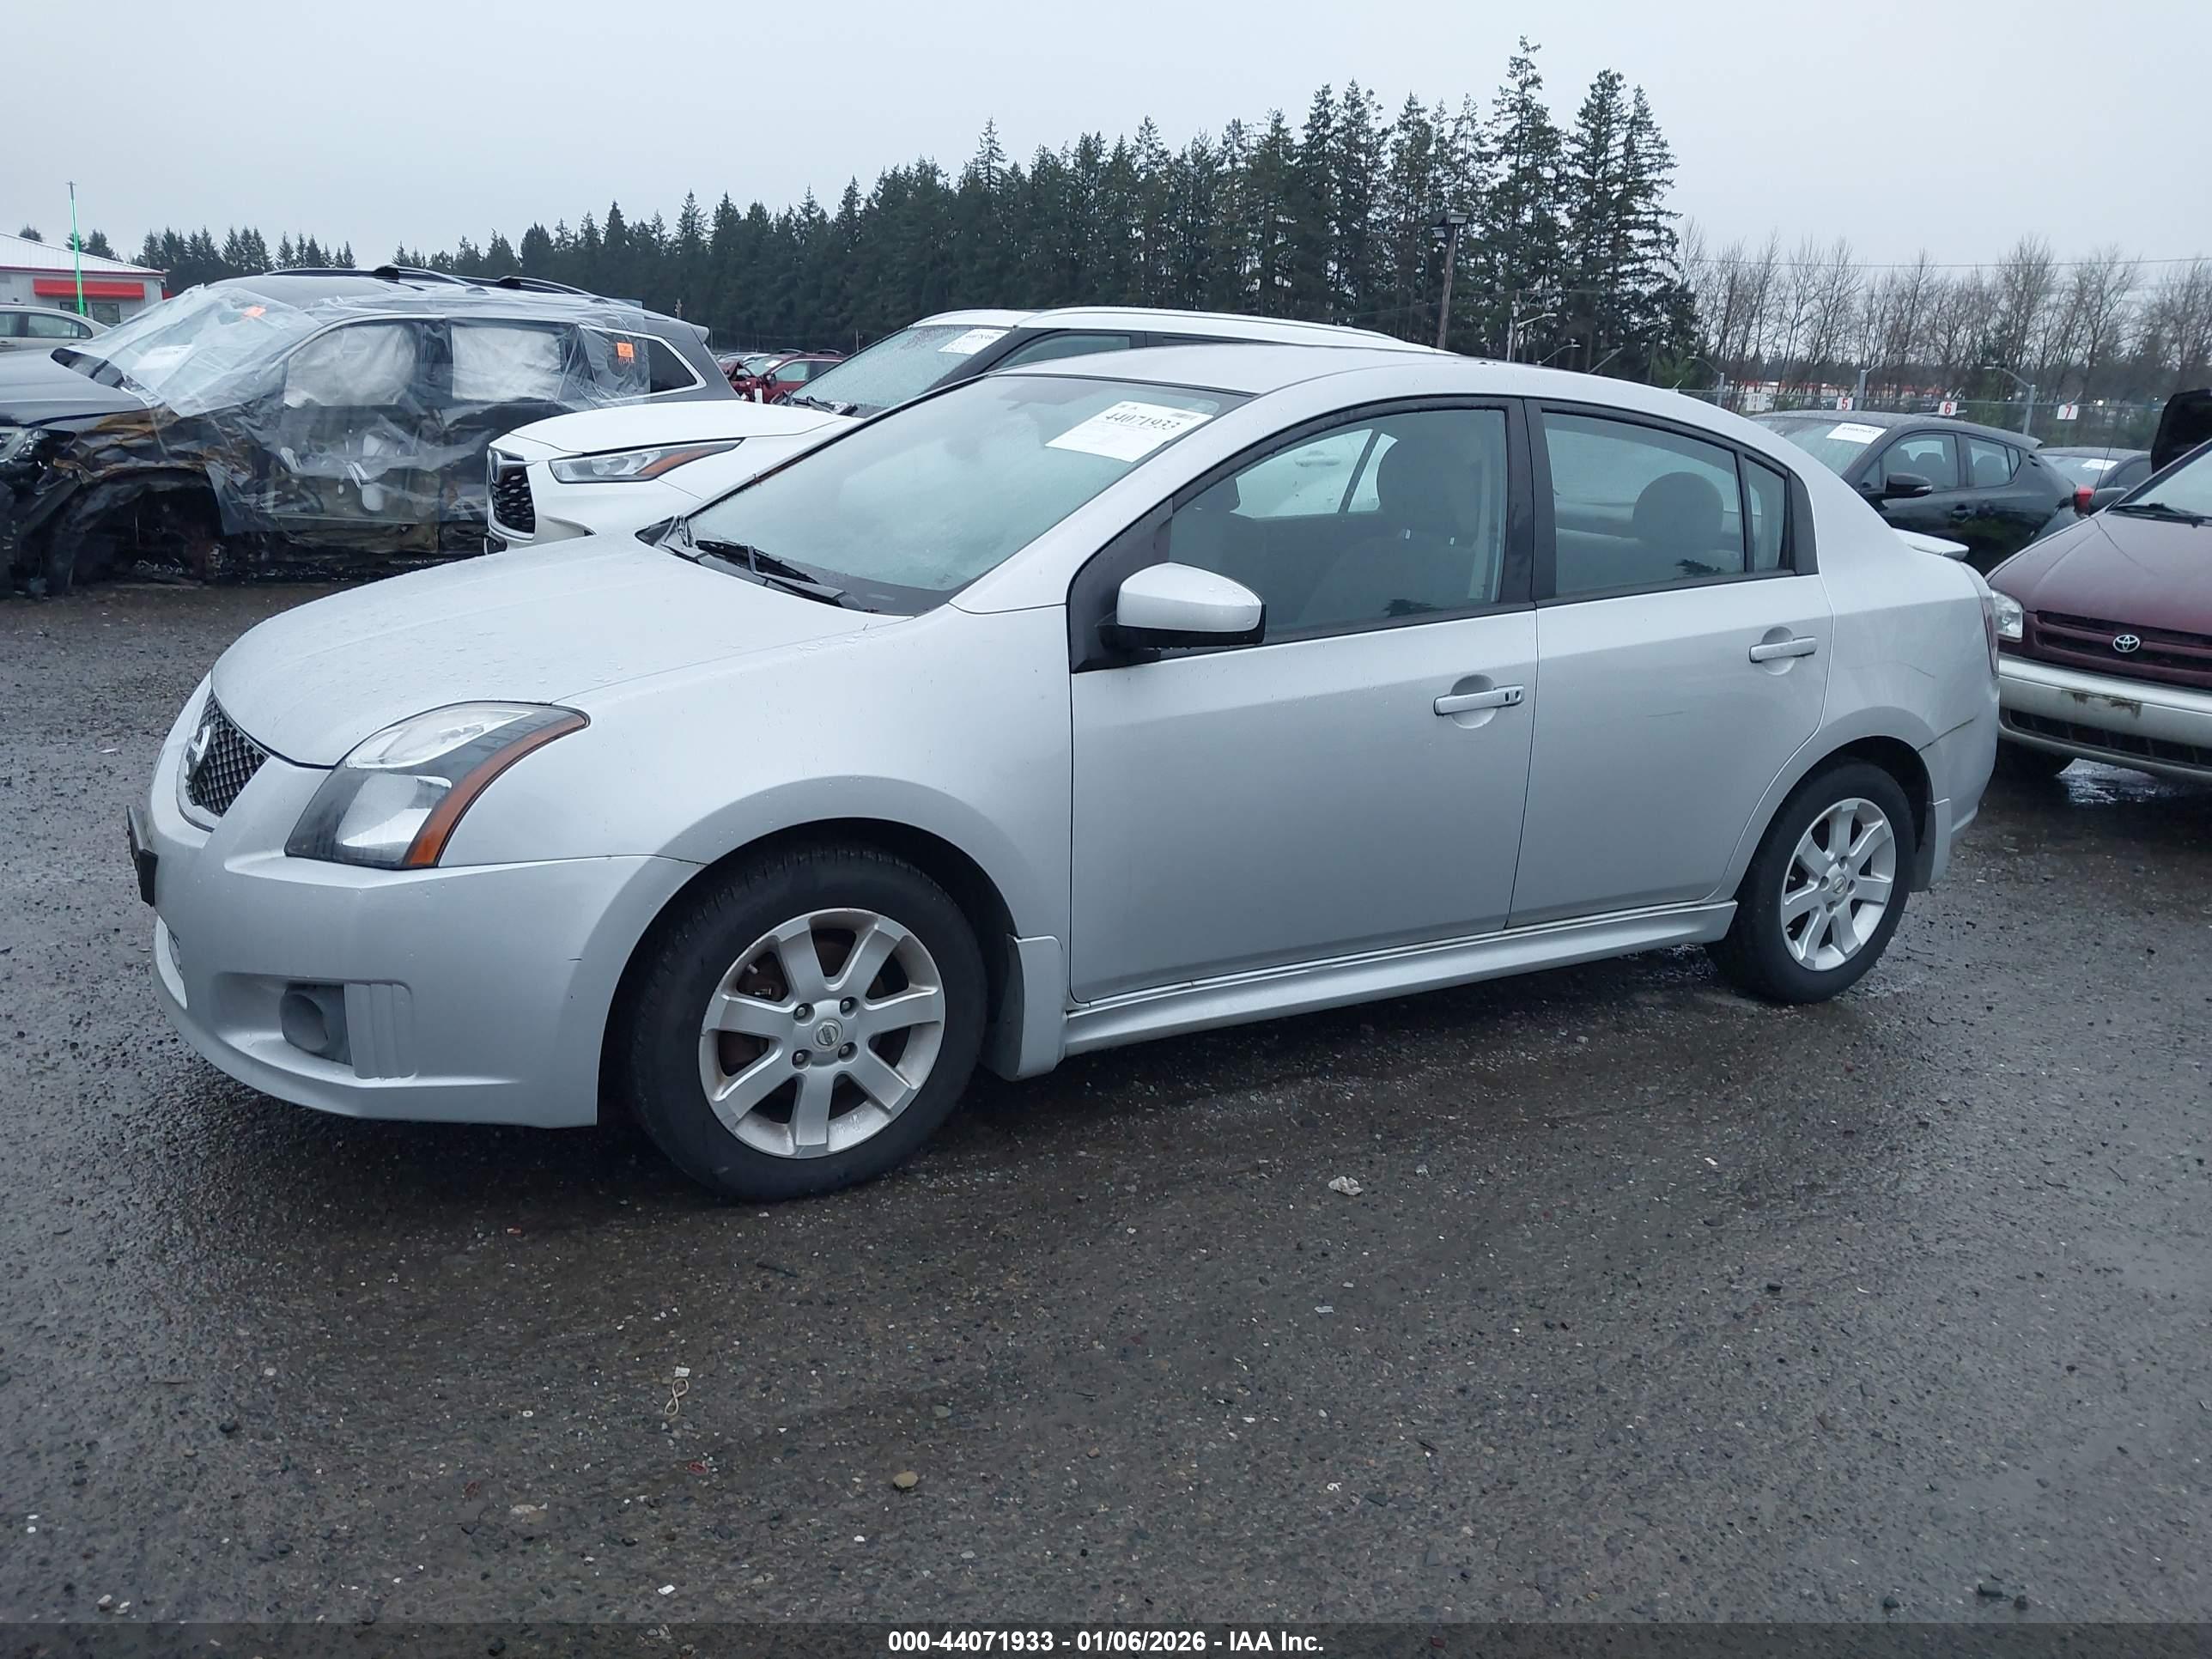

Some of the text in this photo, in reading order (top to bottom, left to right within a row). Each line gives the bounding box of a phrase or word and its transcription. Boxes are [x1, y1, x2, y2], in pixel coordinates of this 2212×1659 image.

[1841, 398, 1849, 411] 5
[1944, 402, 1952, 415] 6
[2064, 404, 2074, 420] 7
